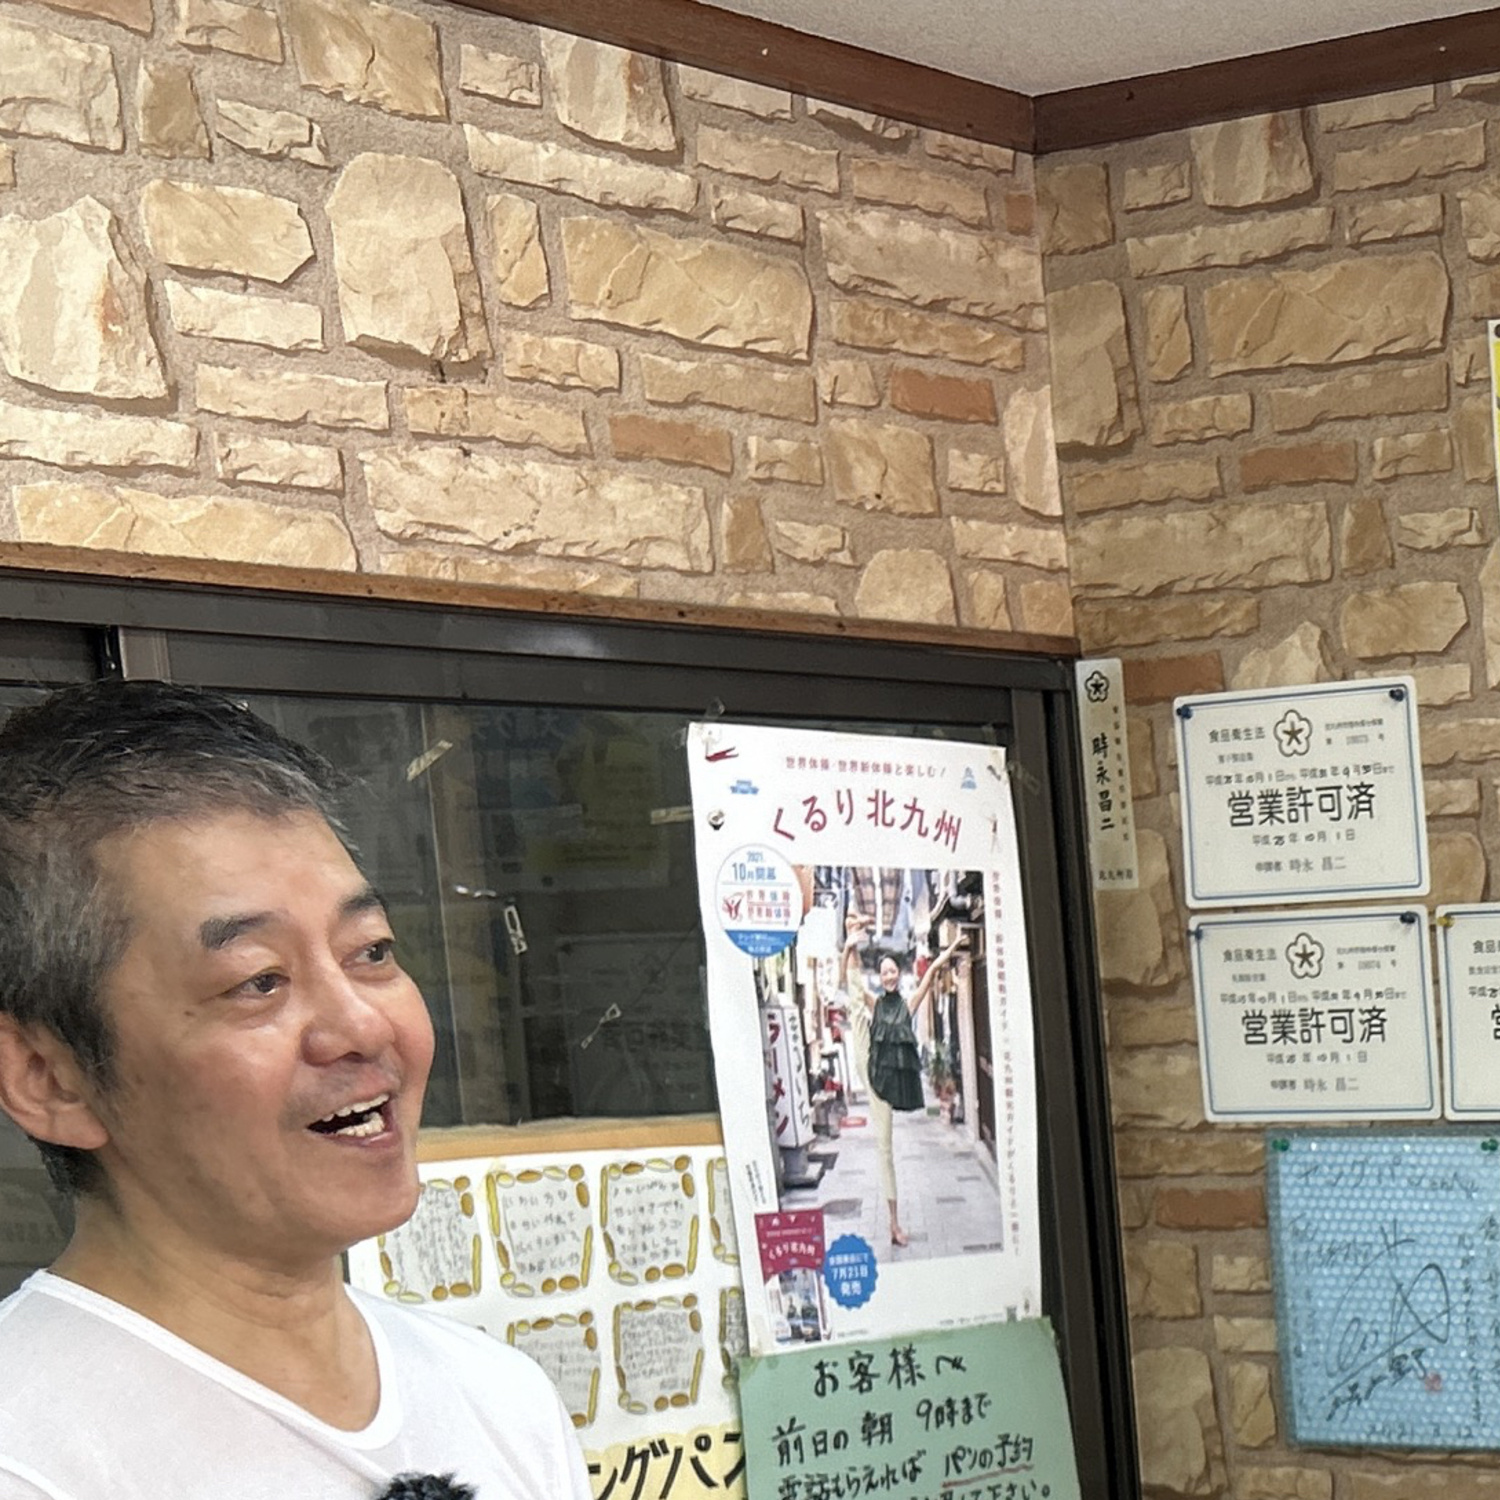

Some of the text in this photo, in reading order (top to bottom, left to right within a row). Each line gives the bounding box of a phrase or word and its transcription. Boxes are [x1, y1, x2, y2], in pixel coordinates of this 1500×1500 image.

[773, 787, 963, 853] くるり北九州
[1227, 781, 1375, 828] 営業許可済
[1241, 1005, 1388, 1046] 営業許可済
[813, 1342, 967, 1398] お客様へ
